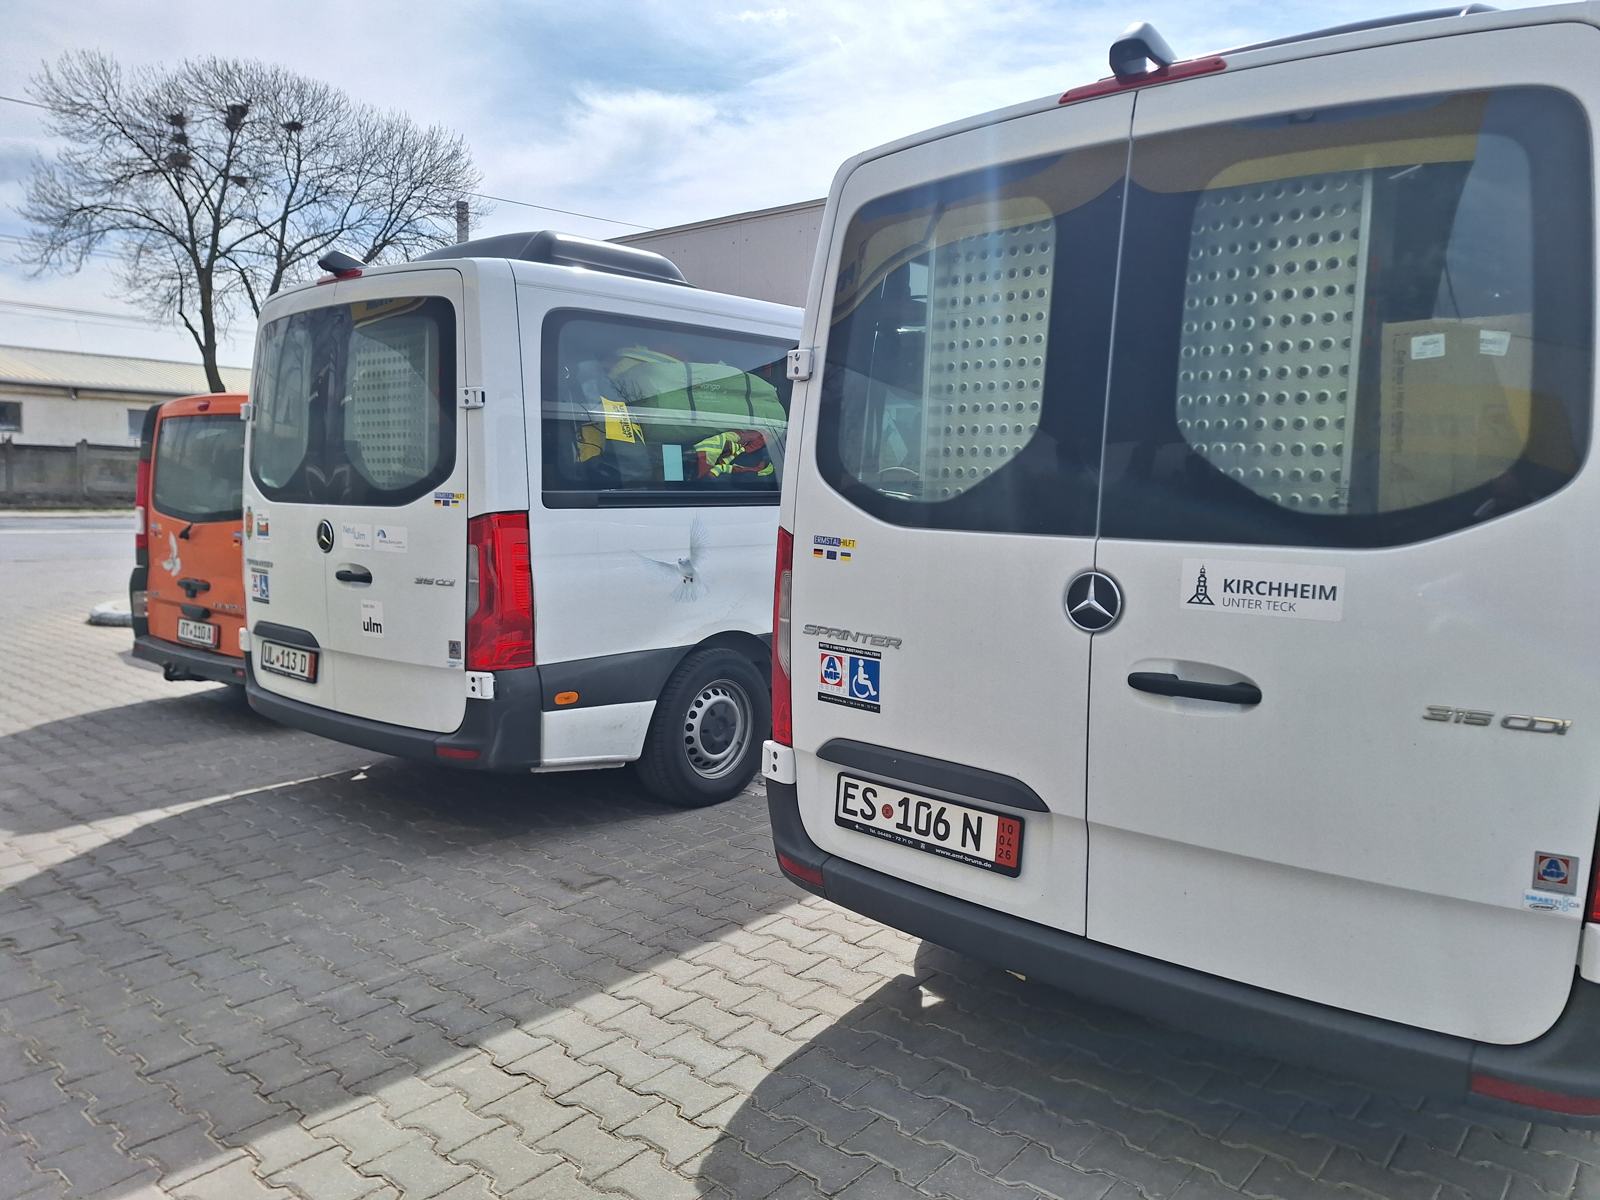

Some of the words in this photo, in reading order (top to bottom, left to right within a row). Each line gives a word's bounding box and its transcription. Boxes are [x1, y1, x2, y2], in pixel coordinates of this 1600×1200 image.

[1223, 578, 1338, 601] KIRCHHEIM
[1222, 597, 1262, 610] UNTER
[1263, 600, 1297, 612] TECK
[363, 616, 383, 634] ulm
[803, 624, 902, 649] SPRINTER
[264, 645, 275, 665] UL
[280, 649, 297, 671] 113
[300, 654, 307, 673] D
[1422, 704, 1495, 727] 315
[843, 781, 878, 821] ES
[895, 797, 951, 841] 106
[961, 813, 983, 851] N
[1001, 822, 1014, 835] 10
[999, 835, 1012, 847] 04
[998, 847, 1012, 860] 26
